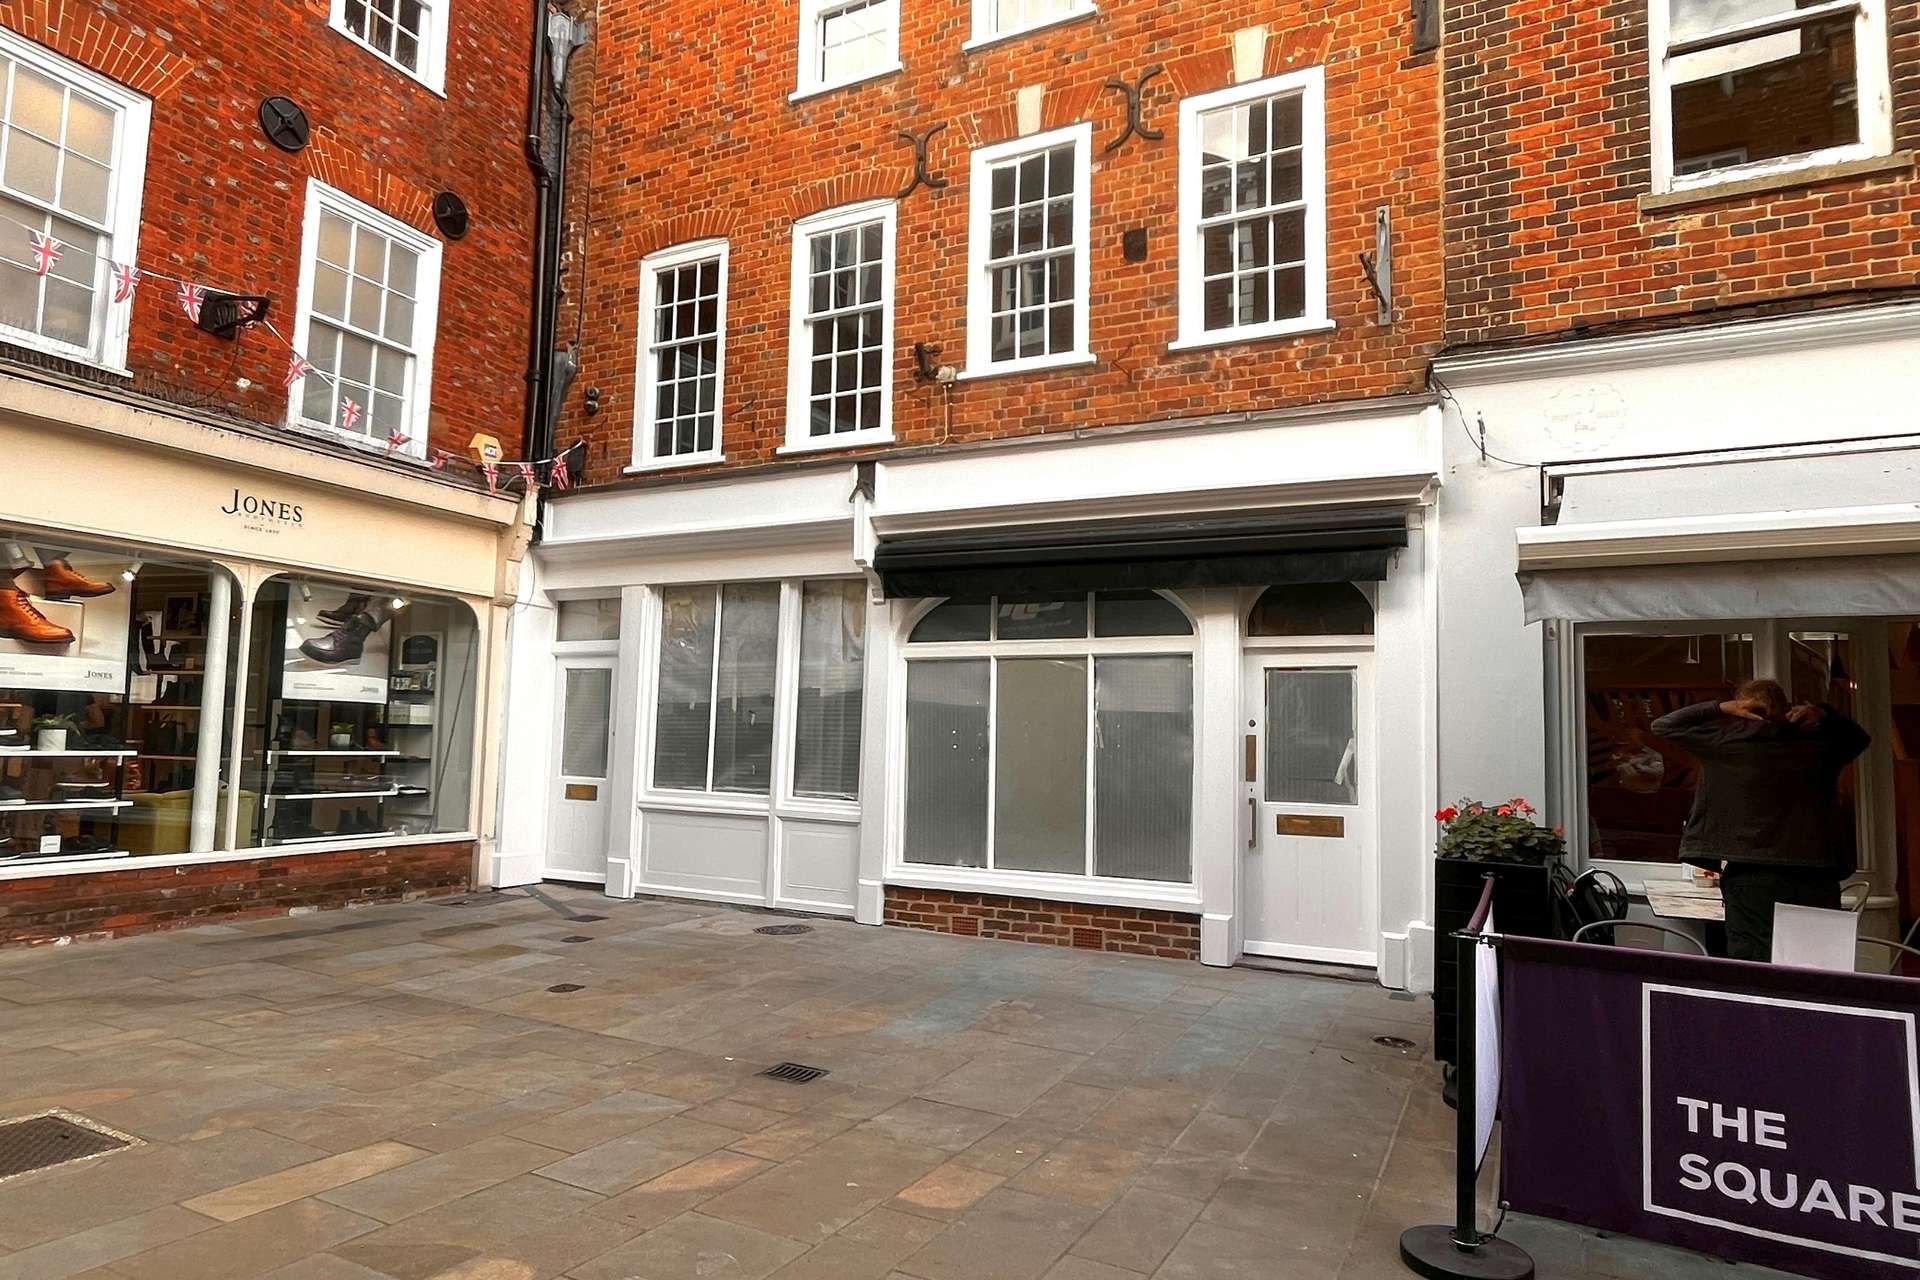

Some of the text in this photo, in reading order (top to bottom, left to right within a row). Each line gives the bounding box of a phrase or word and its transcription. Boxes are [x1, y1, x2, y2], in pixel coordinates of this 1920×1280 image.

[221, 488, 303, 523] JONES
[84, 670, 113, 680] JONES
[1677, 1096, 1787, 1150] THE
[1679, 1153, 1920, 1234] SQUARE
